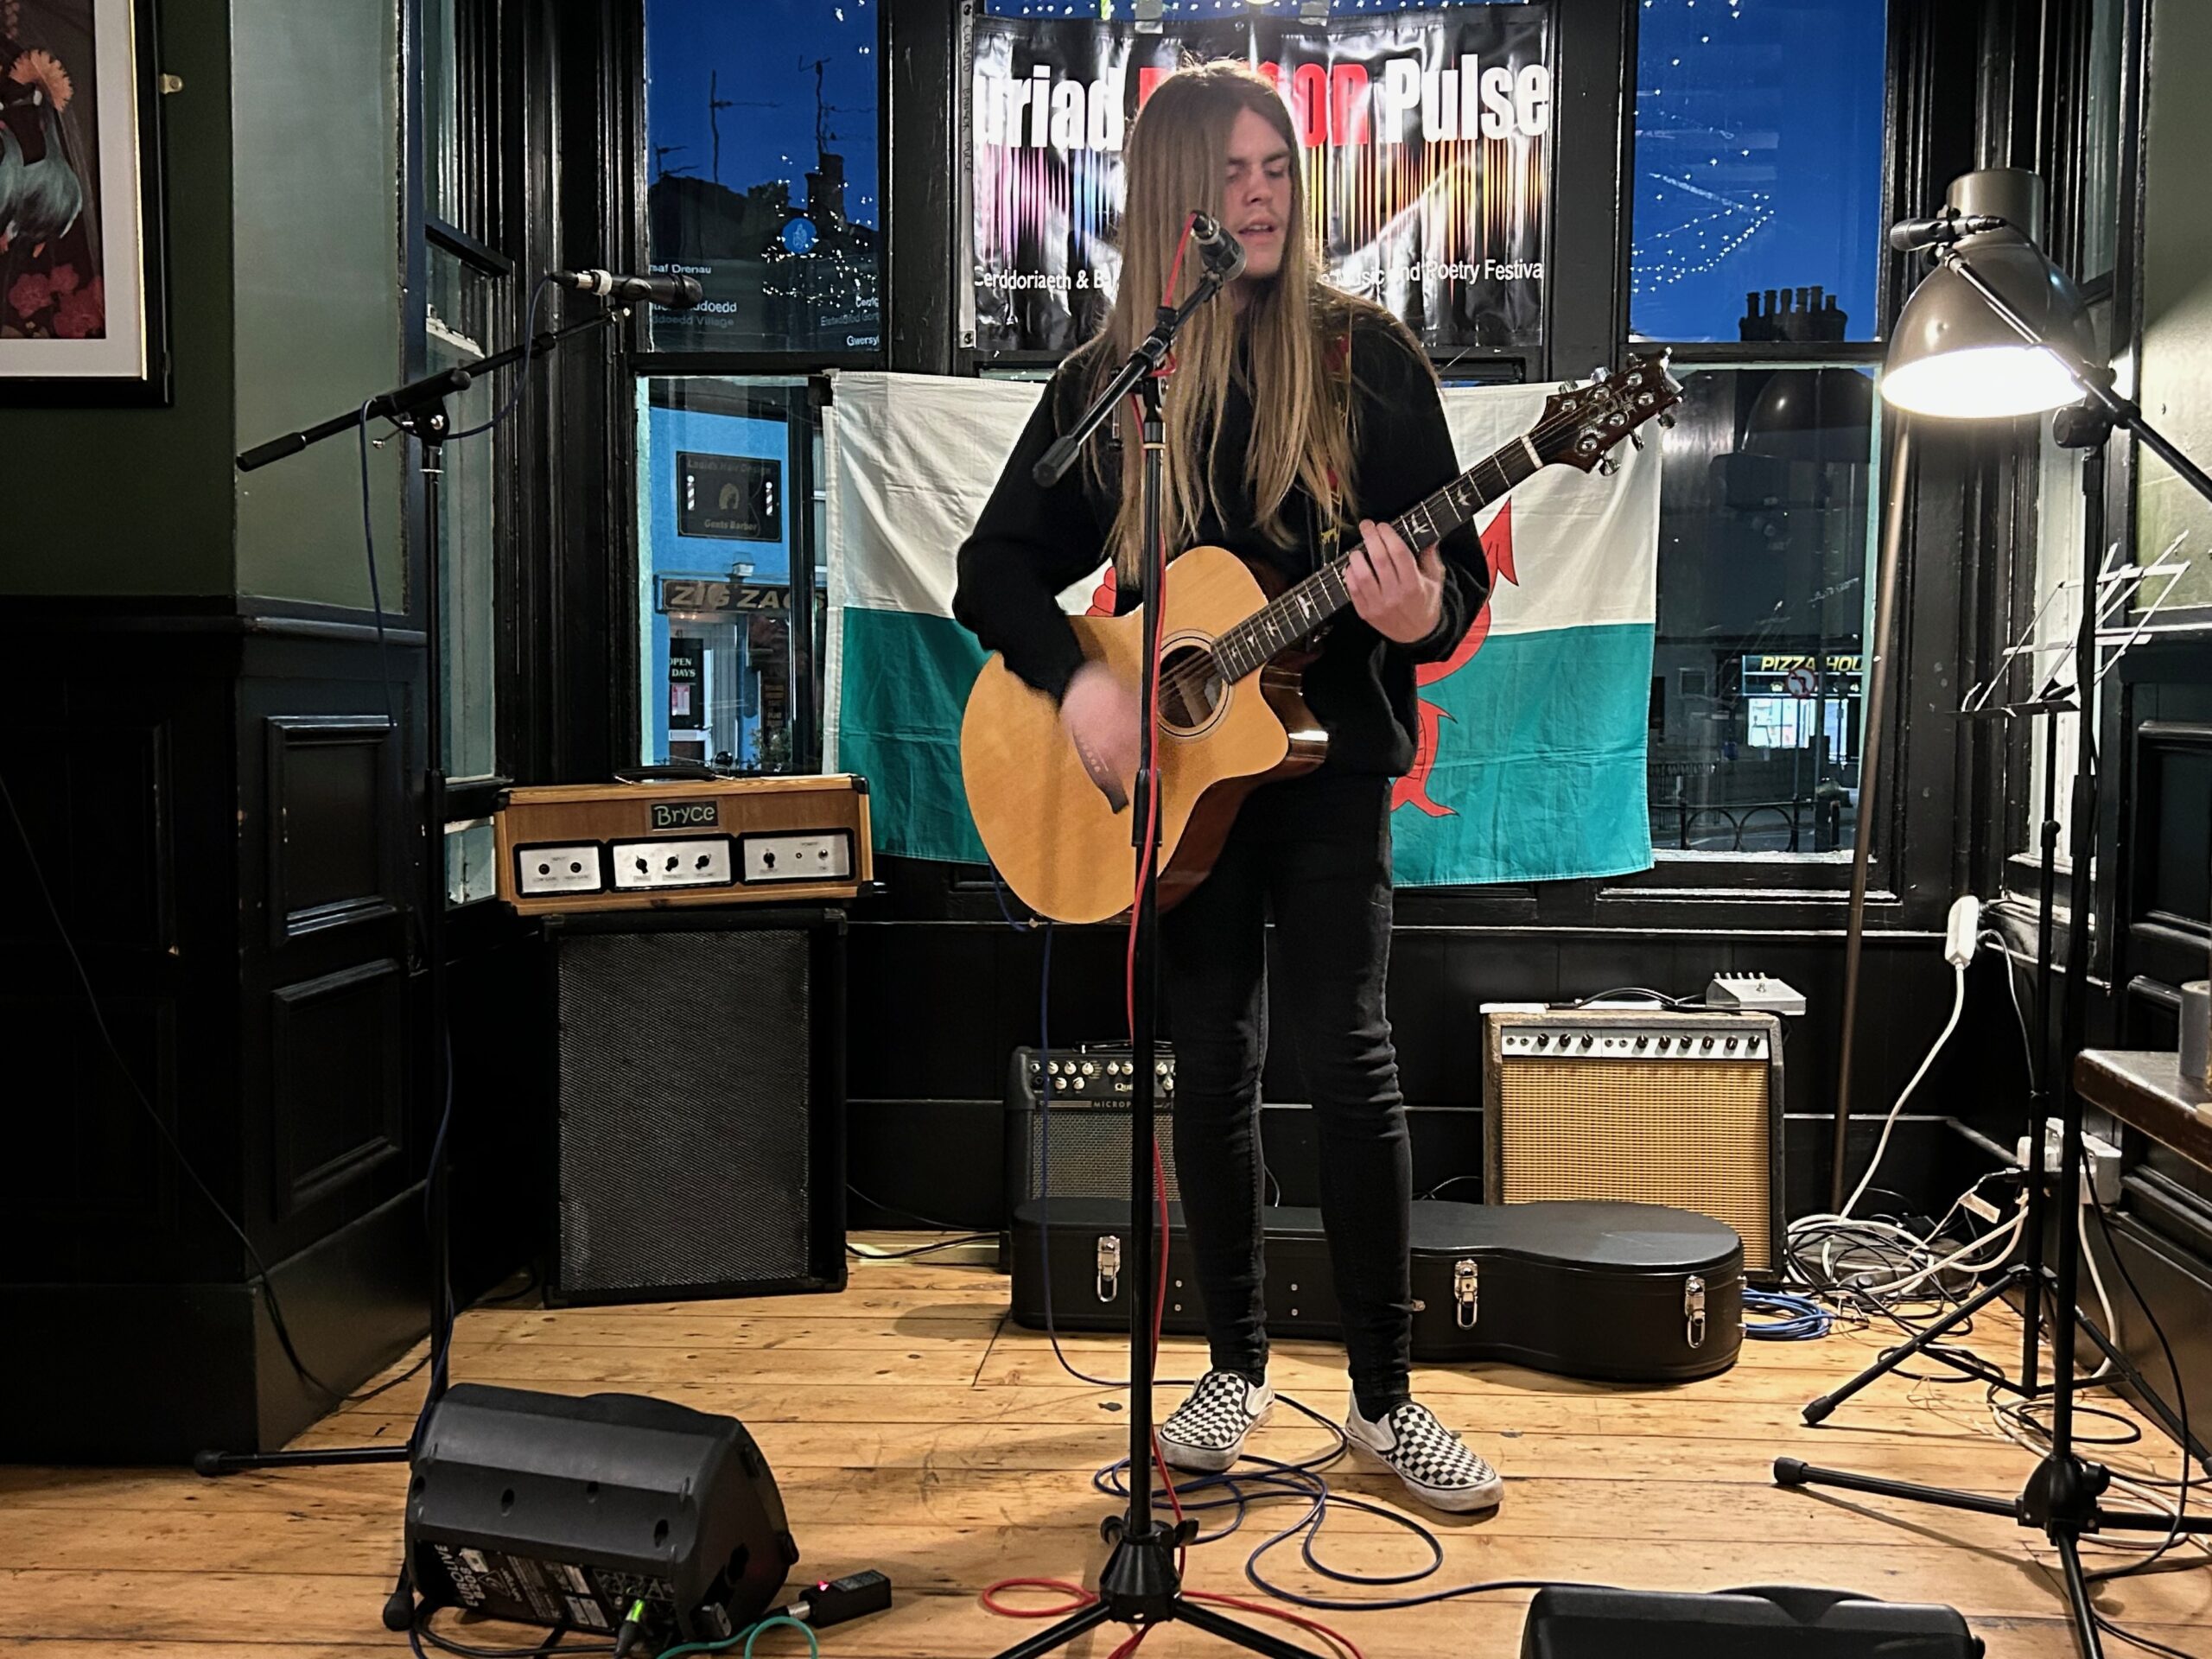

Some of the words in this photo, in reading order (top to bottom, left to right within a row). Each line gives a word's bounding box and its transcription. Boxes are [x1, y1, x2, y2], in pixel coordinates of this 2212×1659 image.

[1385, 54, 1550, 143] Pulse
[671, 264, 712, 274] Drenau
[1076, 269, 1090, 289] &
[1426, 259, 1480, 285] Poetry
[696, 315, 734, 328] Village
[671, 586, 730, 608] ZIG
[736, 588, 826, 610] ZAS
[671, 668, 696, 678] DAYS
[1761, 656, 1815, 672] PIZZA
[653, 805, 715, 826] Bryce
[435, 1543, 480, 1607] EUROLIVE
